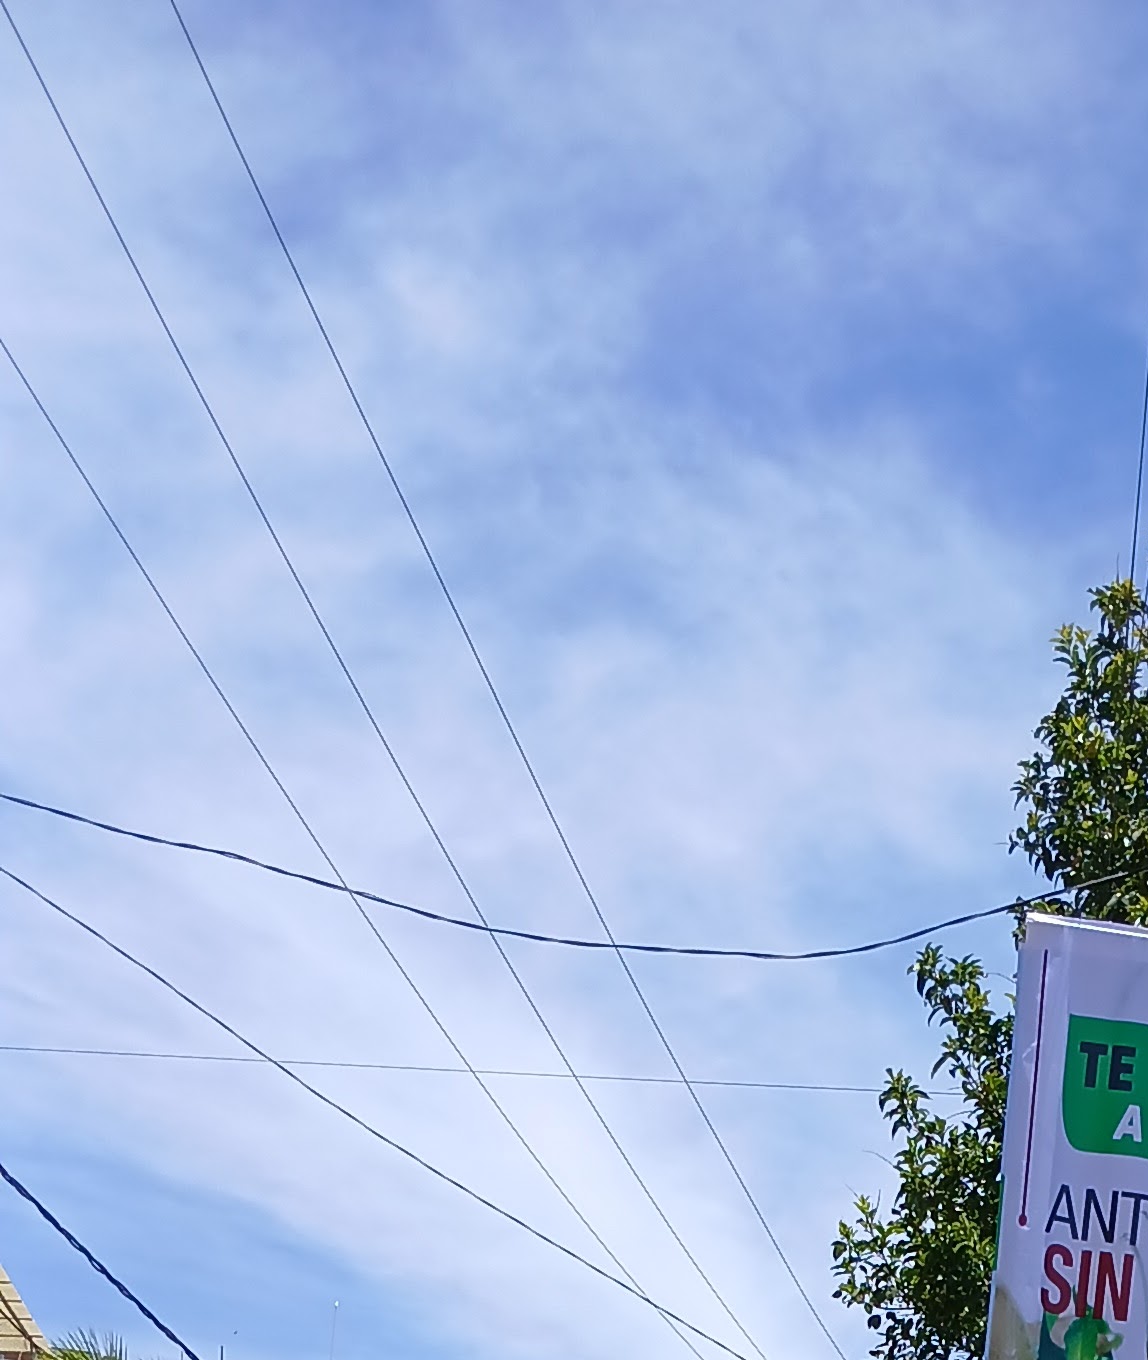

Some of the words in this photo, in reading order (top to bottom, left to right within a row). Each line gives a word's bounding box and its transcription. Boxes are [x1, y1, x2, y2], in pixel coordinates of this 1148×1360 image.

[1079, 1041, 1137, 1090] TE
[1112, 1104, 1143, 1143] A
[1040, 1243, 1135, 1323] SIN
